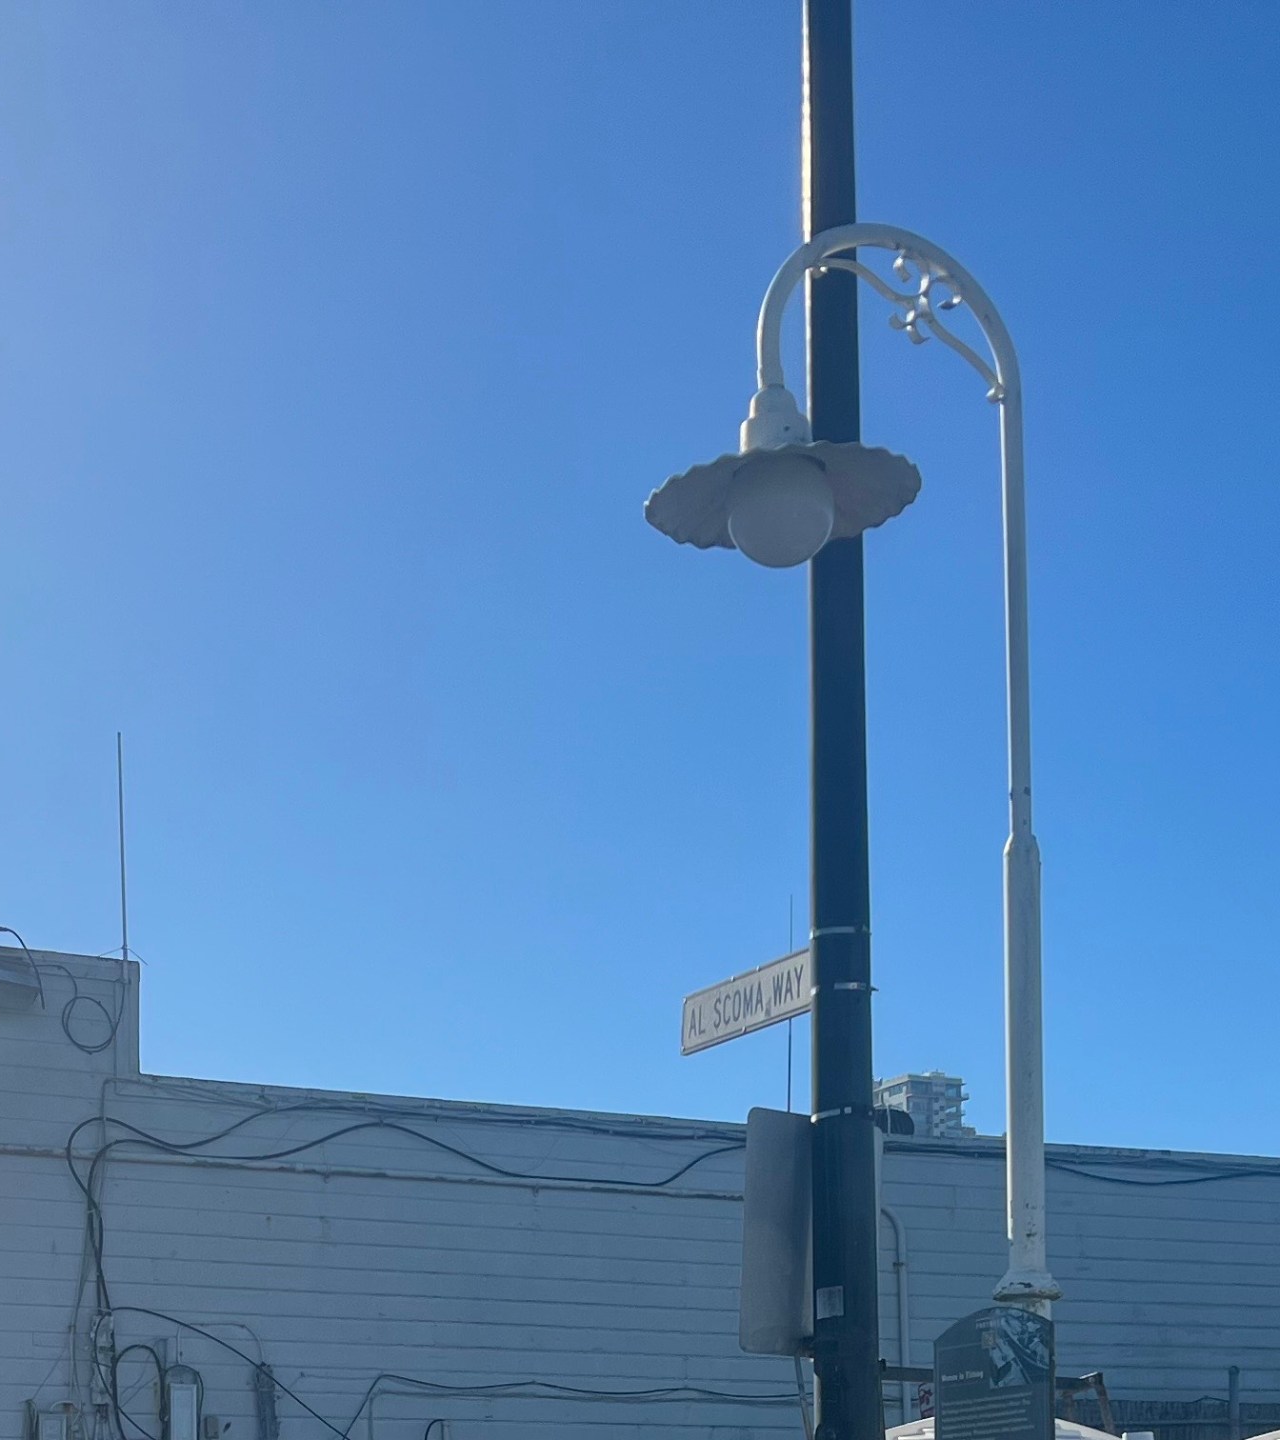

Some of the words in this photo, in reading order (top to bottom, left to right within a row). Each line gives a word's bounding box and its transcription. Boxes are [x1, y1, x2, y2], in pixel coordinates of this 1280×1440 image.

[688, 1006, 706, 1039] AL
[713, 980, 764, 1030] SCOMA
[772, 963, 805, 1008] WAY
